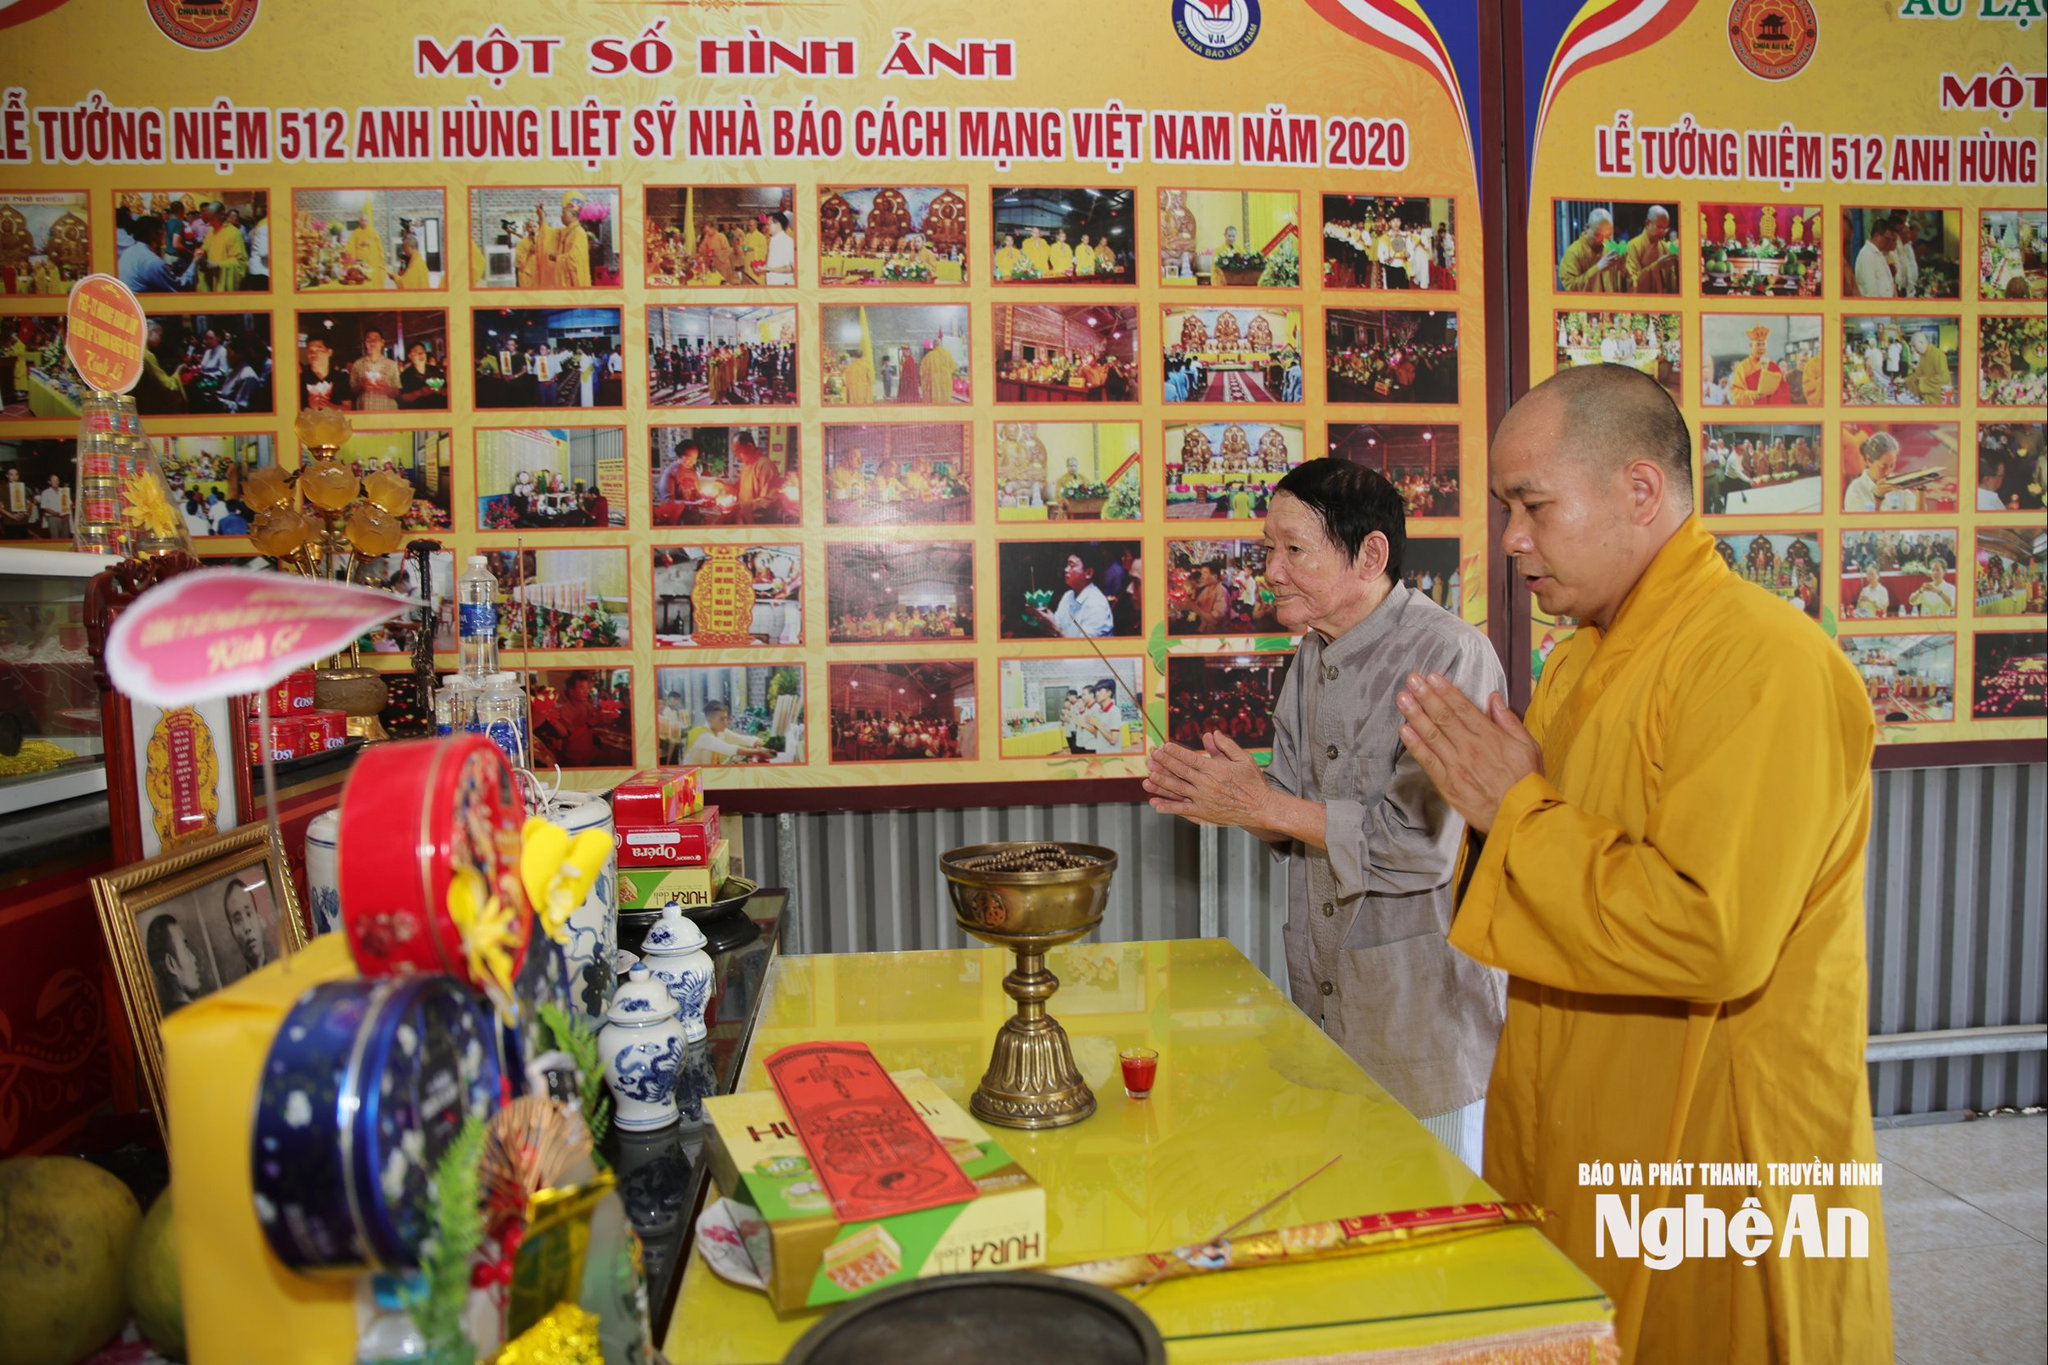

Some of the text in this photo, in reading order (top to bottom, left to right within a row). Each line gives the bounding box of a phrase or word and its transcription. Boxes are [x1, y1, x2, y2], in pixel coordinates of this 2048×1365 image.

[420, 22, 1011, 85] MỘT SỐ HÌNH ẢNH
[1208, 33, 1226, 44] VJA
[1944, 66, 2046, 118] MỘT
[40, 95, 161, 160] TƯỞNG
[176, 102, 267, 170] NIỆM
[282, 112, 344, 158] 512
[358, 112, 428, 157] ANH
[443, 101, 537, 157] HÙNG
[552, 100, 620, 166] LIỆT
[634, 101, 676, 156] SỸ
[690, 101, 761, 155] NHÀ
[774, 101, 841, 156] BÁO
[856, 101, 946, 156] CÁCH
[960, 112, 1060, 166] MẠNG
[1074, 104, 1142, 168] VIỆT
[1155, 115, 1229, 160] NAM
[1243, 110, 1316, 162] NĂM
[1330, 121, 1404, 166] 2020
[1600, 115, 2035, 187] LỄ TƯỞNG NIỆM 512 ANH HÙNG
[633, 844, 677, 860] Opéra
[671, 891, 708, 905] HURA
[970, 1232, 1040, 1268] HURA
